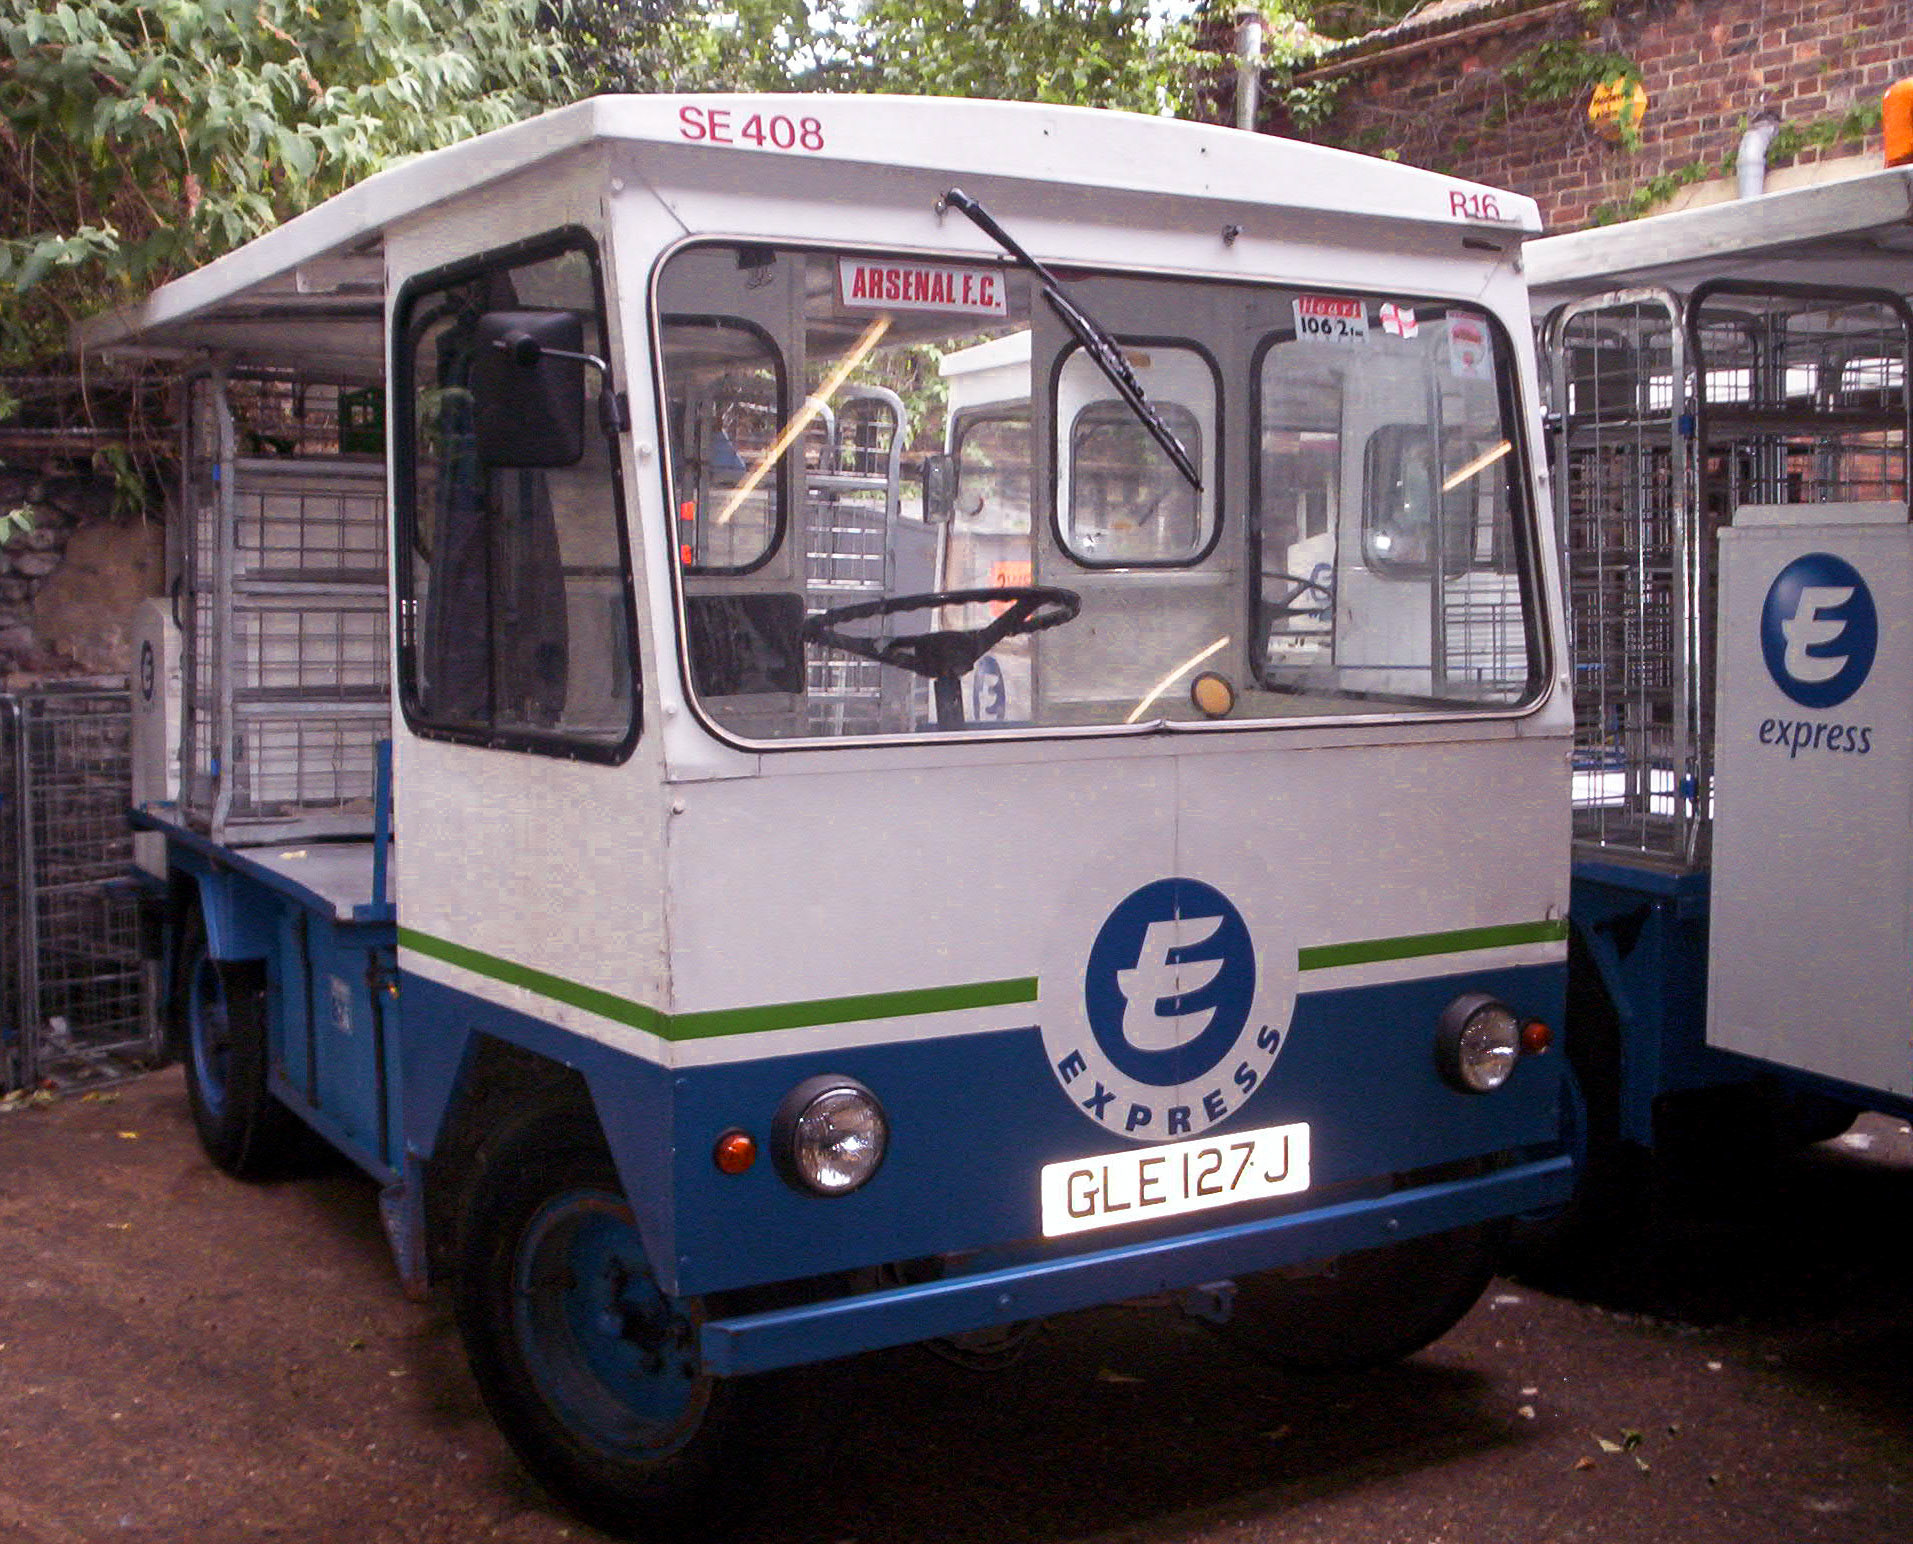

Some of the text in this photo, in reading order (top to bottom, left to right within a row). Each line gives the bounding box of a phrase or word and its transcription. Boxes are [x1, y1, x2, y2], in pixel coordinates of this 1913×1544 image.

[679, 105, 825, 151] SE 408
[1449, 191, 1500, 222] R16
[852, 266, 1003, 308] ARSENAL F.C.
[1759, 717, 1873, 759] express
[1057, 1024, 1282, 1136] EXPRESS
